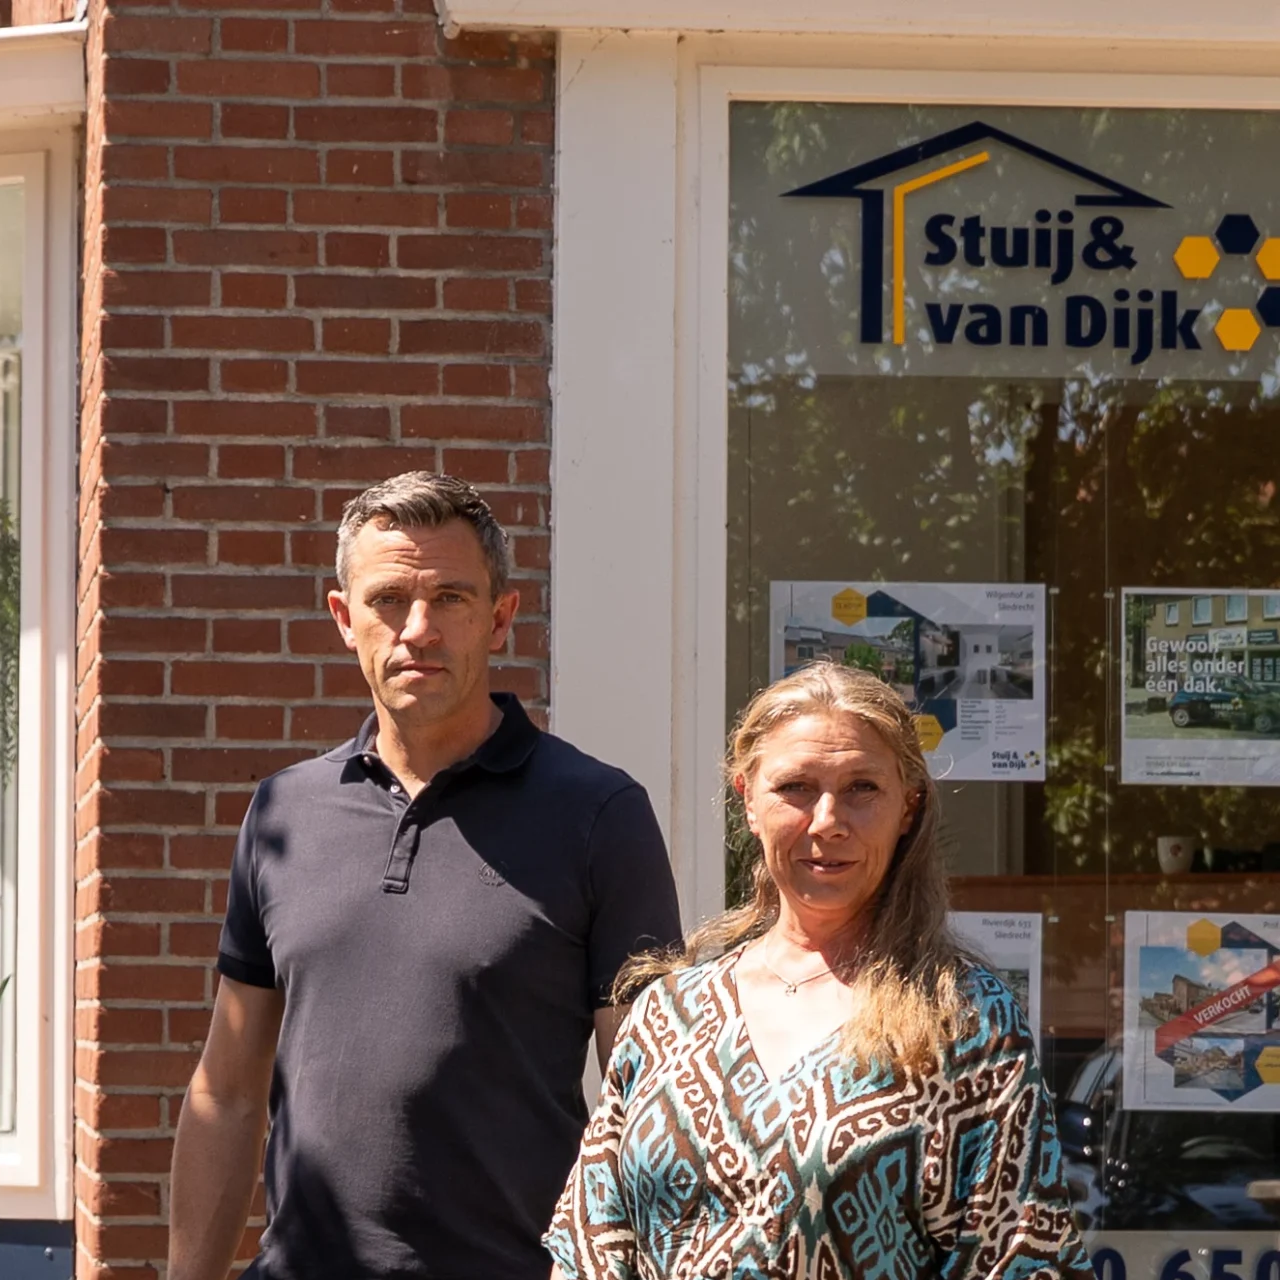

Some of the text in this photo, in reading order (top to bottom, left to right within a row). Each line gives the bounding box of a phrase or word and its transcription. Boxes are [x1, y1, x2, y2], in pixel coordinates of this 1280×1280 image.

[924, 288, 1202, 366] van Dijk
[1145, 636, 1219, 654] Gewoon
[1145, 655, 1246, 673] alles onder
[1145, 675, 1222, 693] één dak.
[991, 750, 1019, 761] Stuij &
[991, 760, 1027, 770] van Dijk
[1193, 985, 1252, 1025] VERKOCHT
